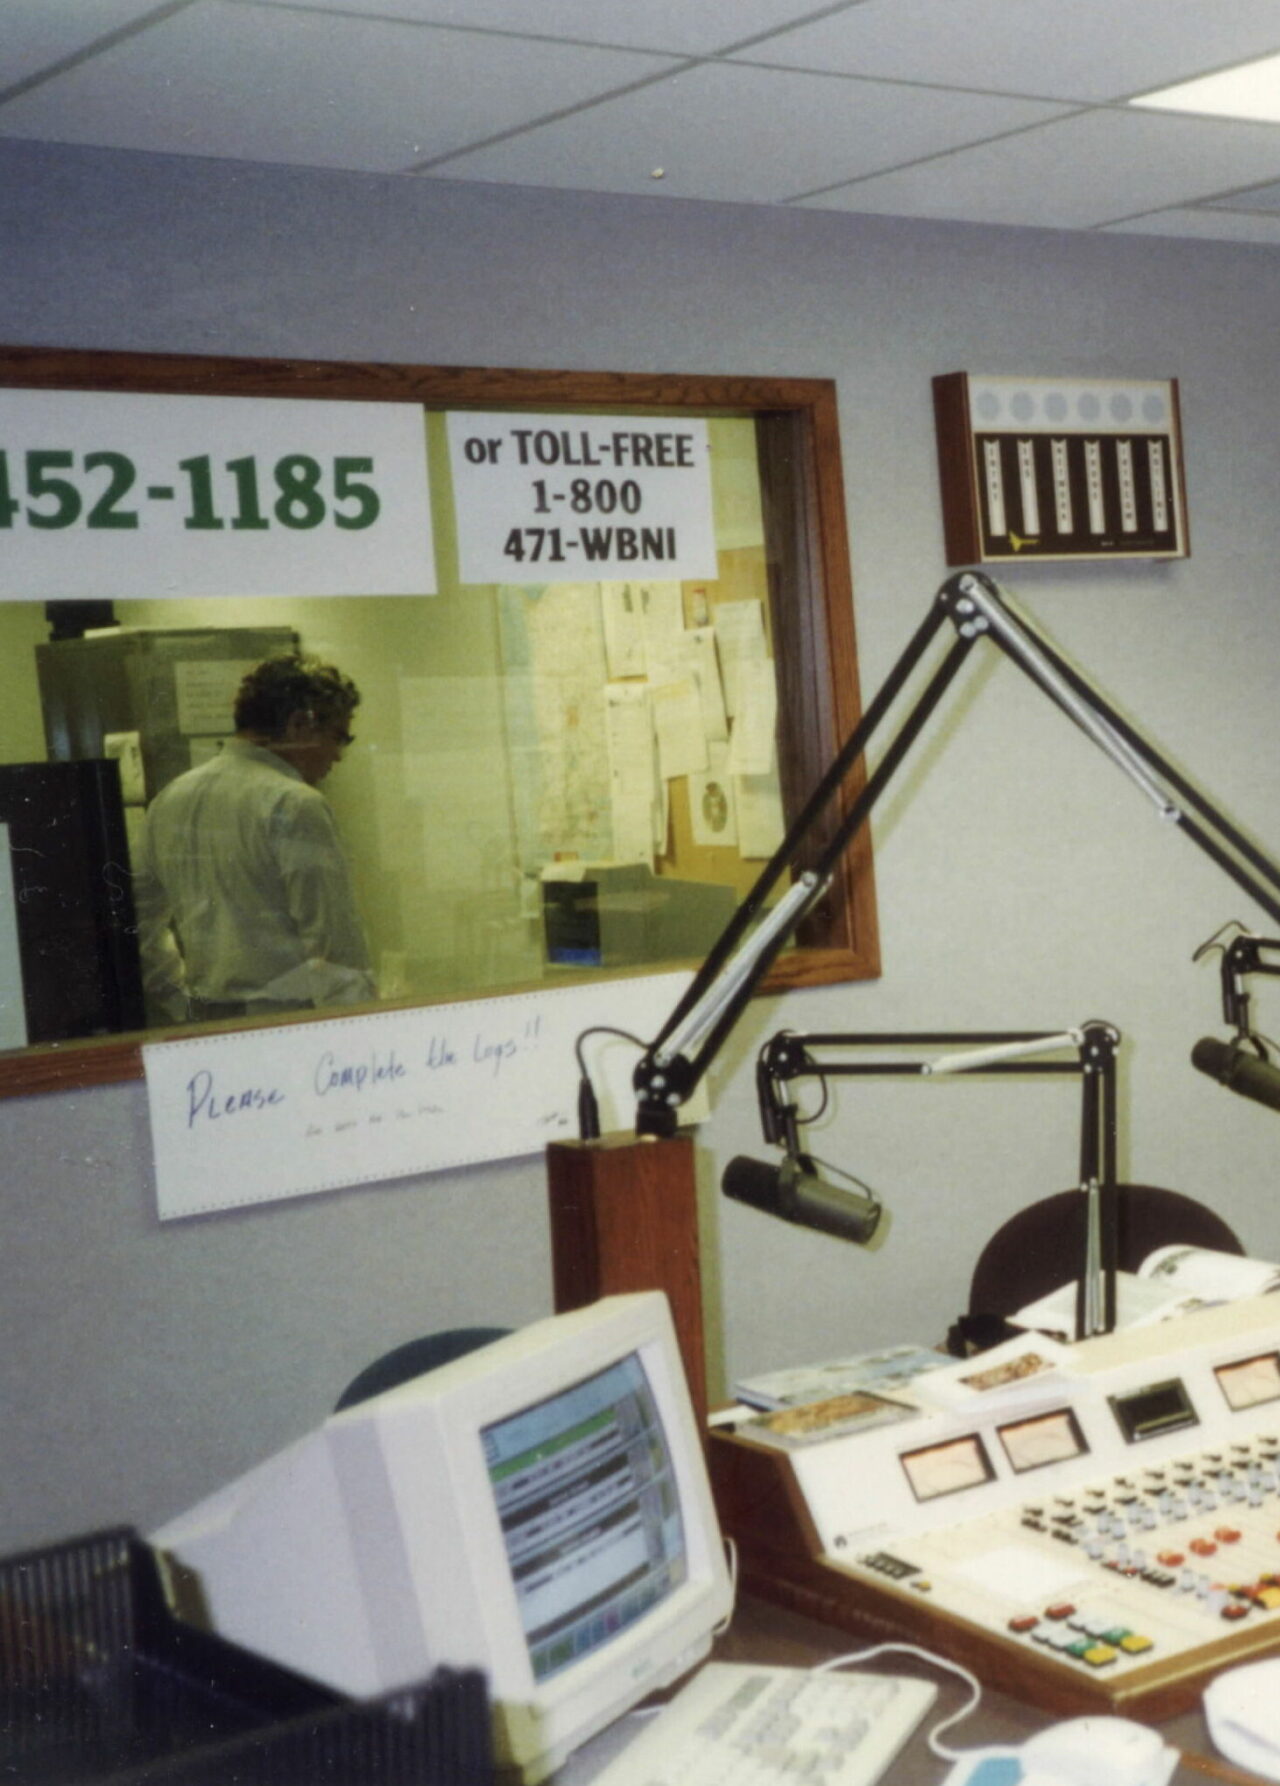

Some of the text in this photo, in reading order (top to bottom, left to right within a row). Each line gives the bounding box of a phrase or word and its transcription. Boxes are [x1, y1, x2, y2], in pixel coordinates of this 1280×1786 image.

[464, 430, 695, 467] or TOLL-FREE
[532, 478, 642, 514] 1-800
[503, 526, 677, 562] 471-WBNI
